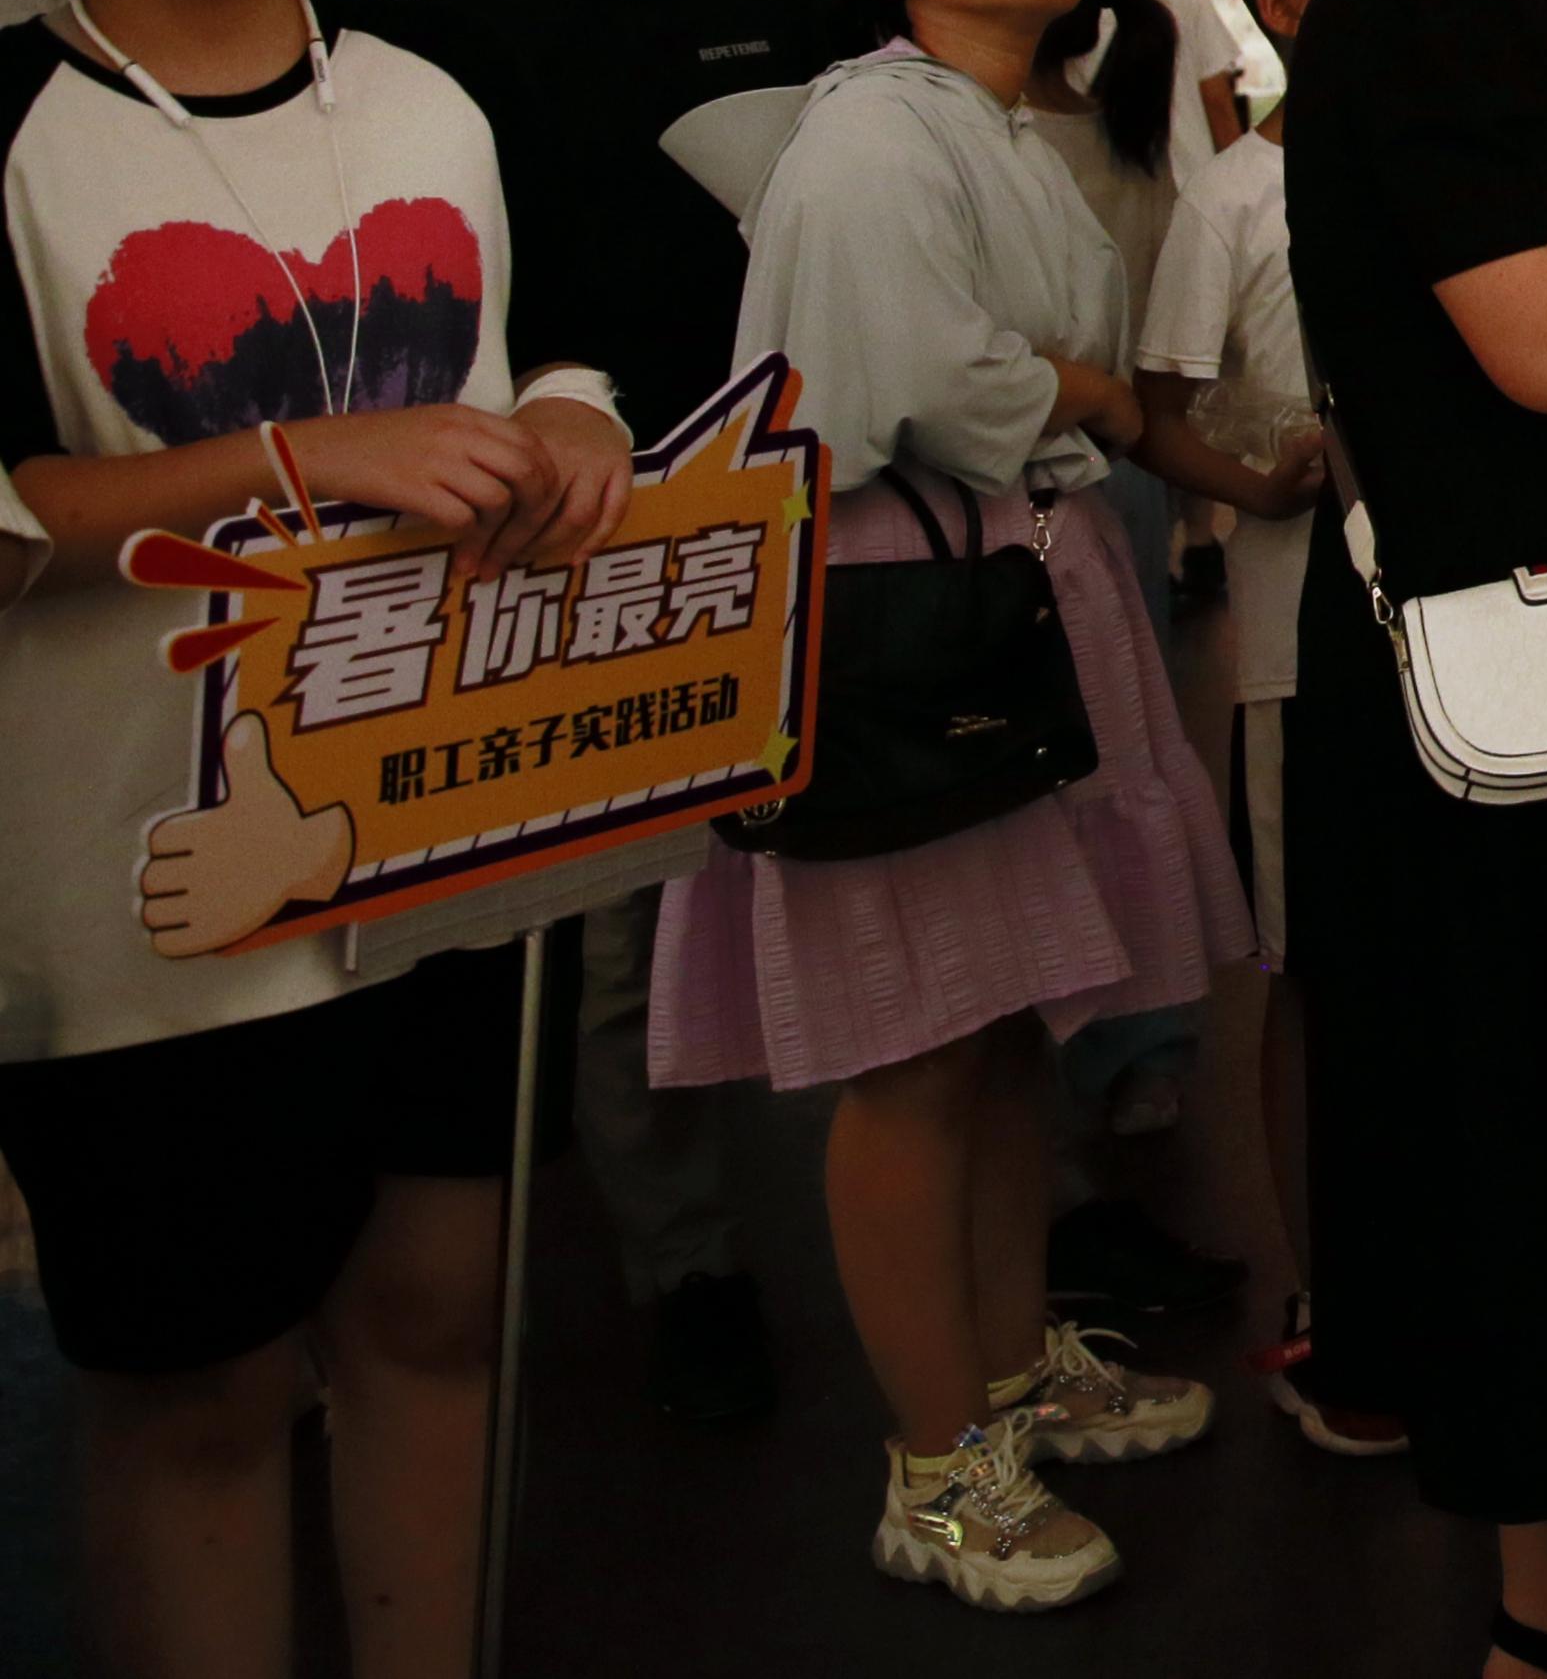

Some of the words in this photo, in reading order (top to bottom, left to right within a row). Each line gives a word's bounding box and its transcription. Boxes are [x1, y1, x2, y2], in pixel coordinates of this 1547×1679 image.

[280, 526, 763, 733] 暑你最亮
[379, 672, 740, 806] 职工亲子实践活动
